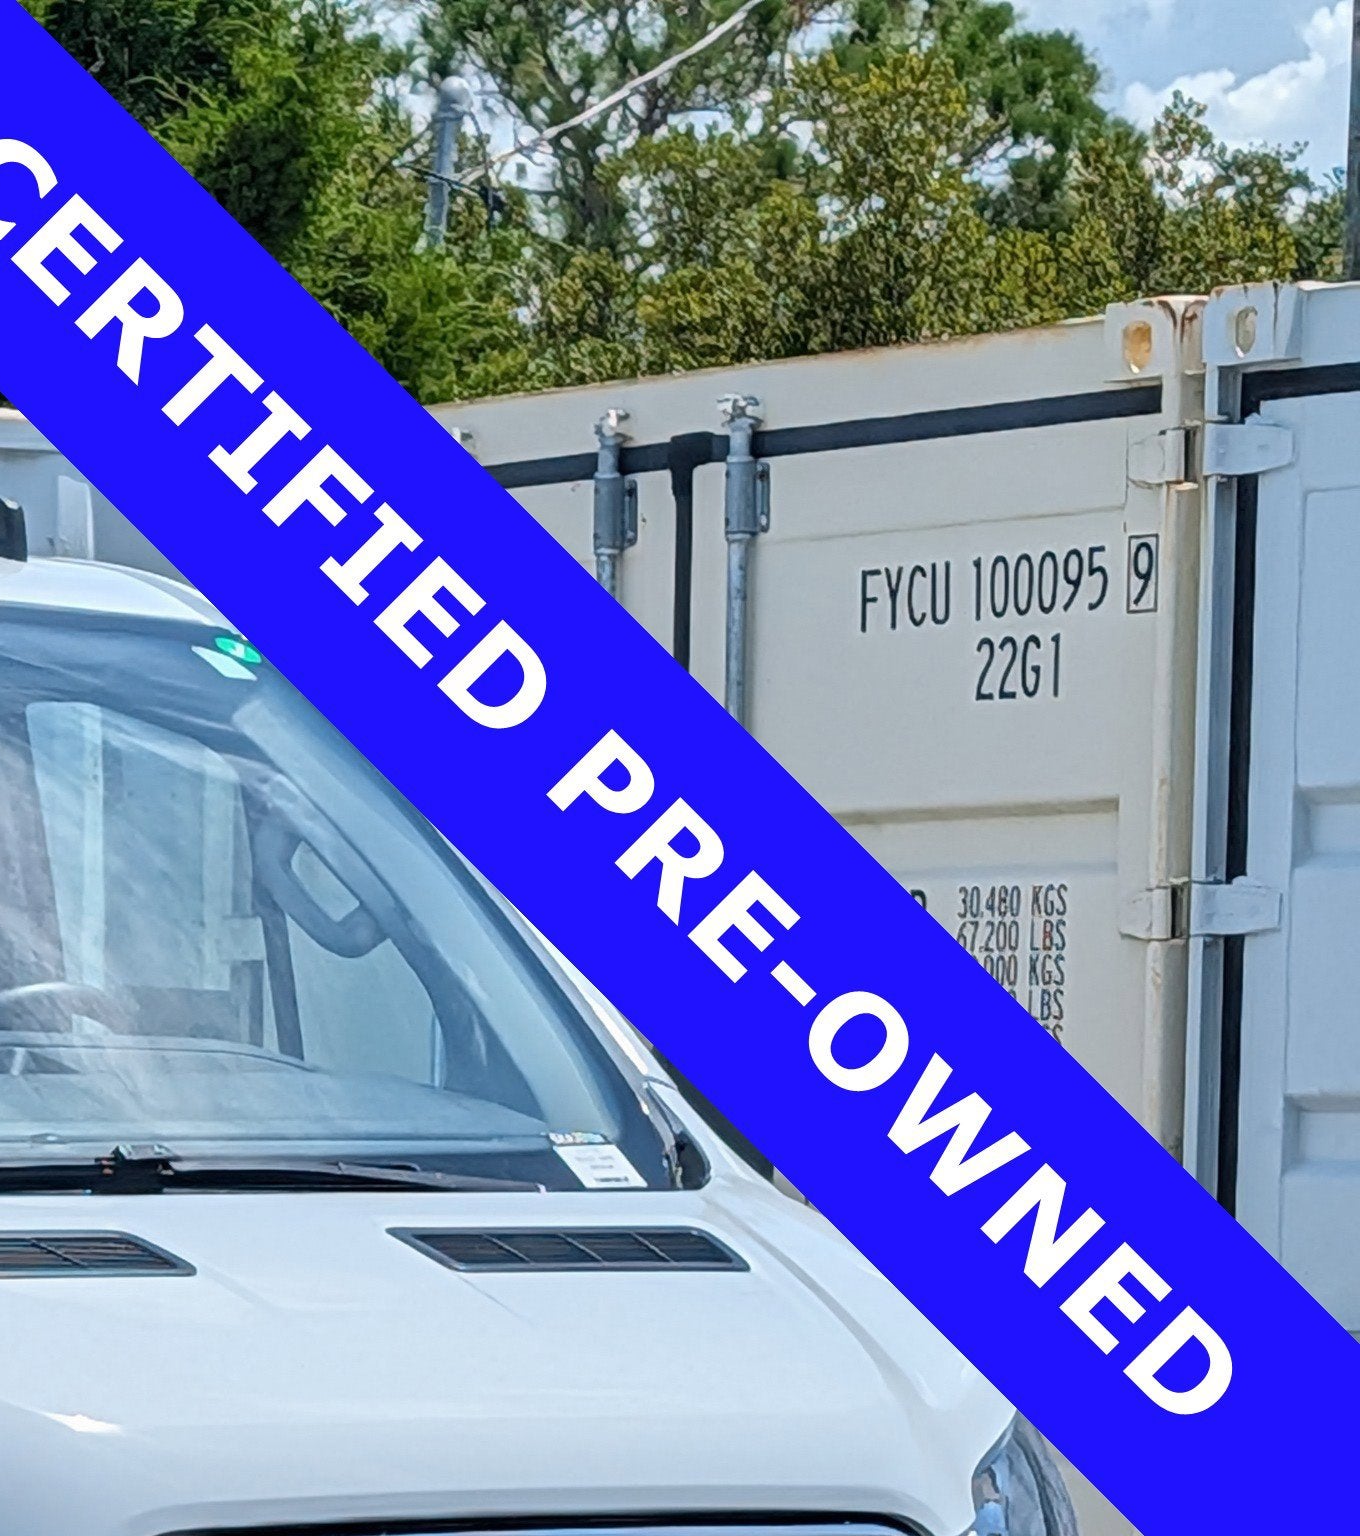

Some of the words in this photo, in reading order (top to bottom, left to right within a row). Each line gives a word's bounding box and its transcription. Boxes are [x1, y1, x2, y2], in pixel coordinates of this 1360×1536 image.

[860, 560, 951, 634] FYCU
[972, 545, 1109, 622] 100095
[1132, 541, 1155, 607] 9
[974, 631, 1062, 702] 22G1
[1030, 883, 1069, 919] KGS
[1029, 918, 1067, 952] LBS
[1028, 952, 1066, 987] KGS
[1028, 987, 1065, 1022] LBS
